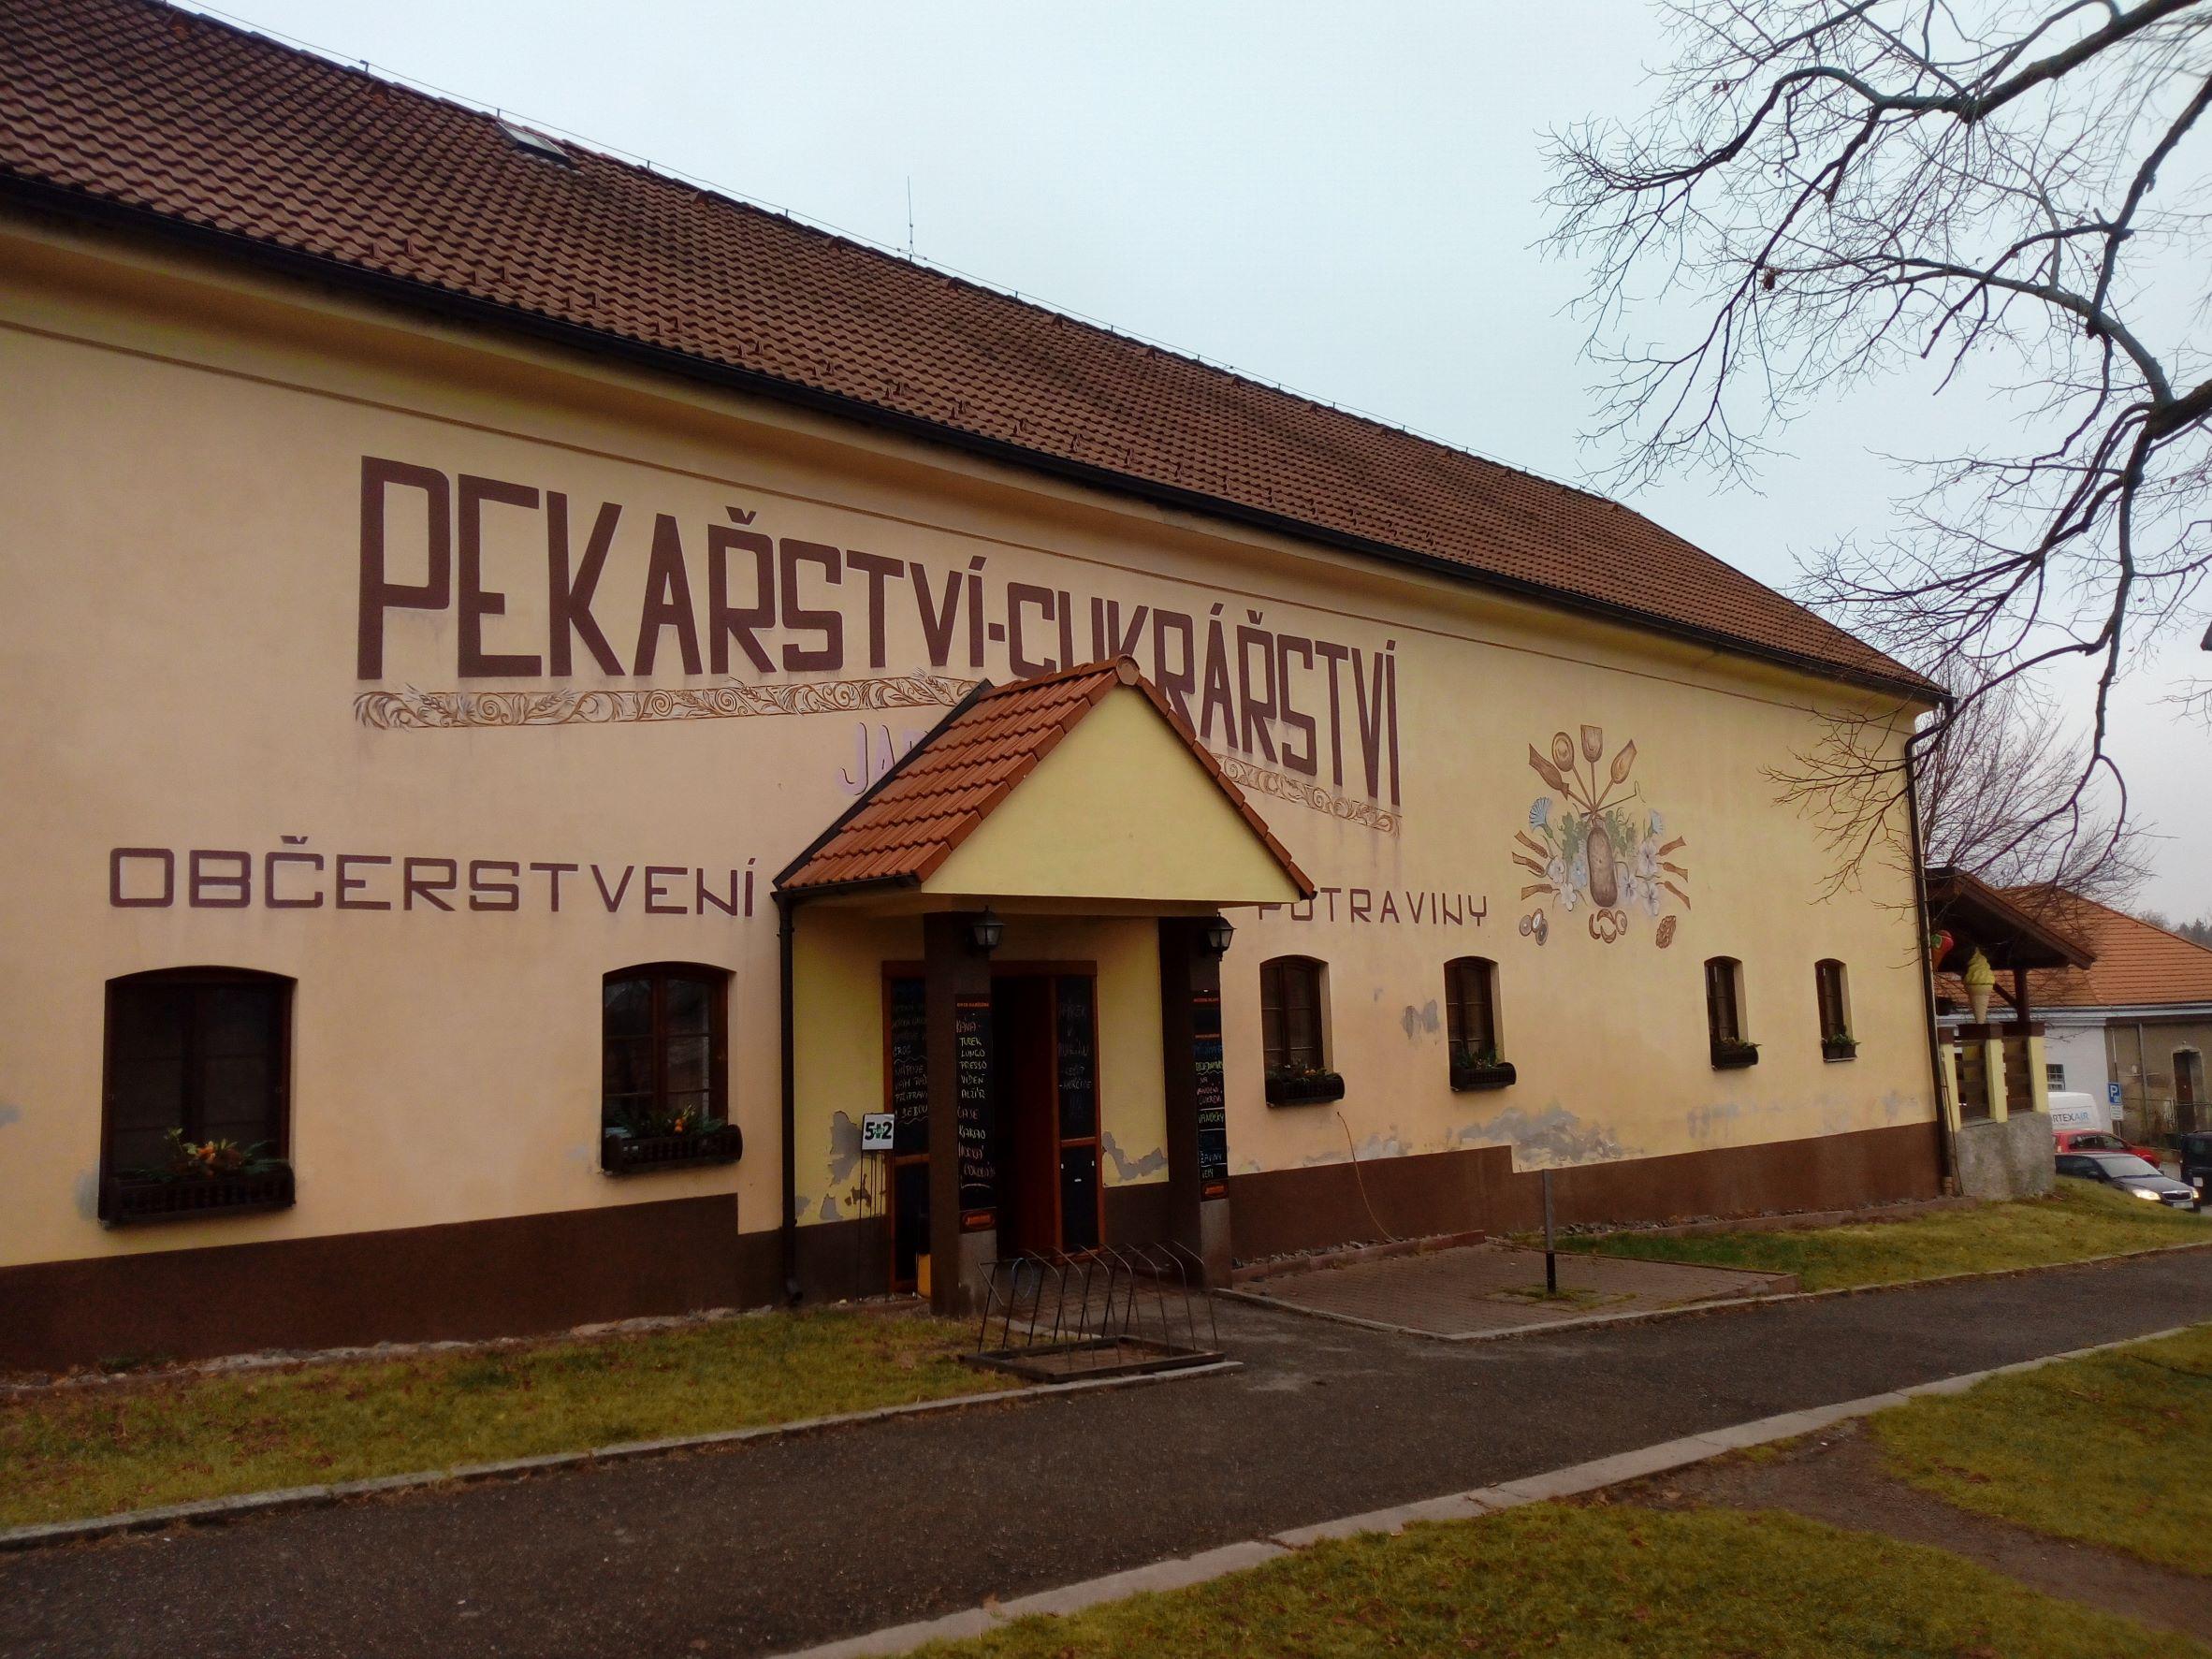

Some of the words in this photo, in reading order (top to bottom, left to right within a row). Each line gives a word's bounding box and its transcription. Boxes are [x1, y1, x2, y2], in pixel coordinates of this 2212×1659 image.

[109, 836, 757, 919] OBČERSTVENÍ
[959, 1037, 982, 1047] TUREK
[959, 1060, 987, 1070] PRESSO
[2050, 1112, 2088, 1123] RTEXAIR
[959, 1124, 985, 1140] KAKAO
